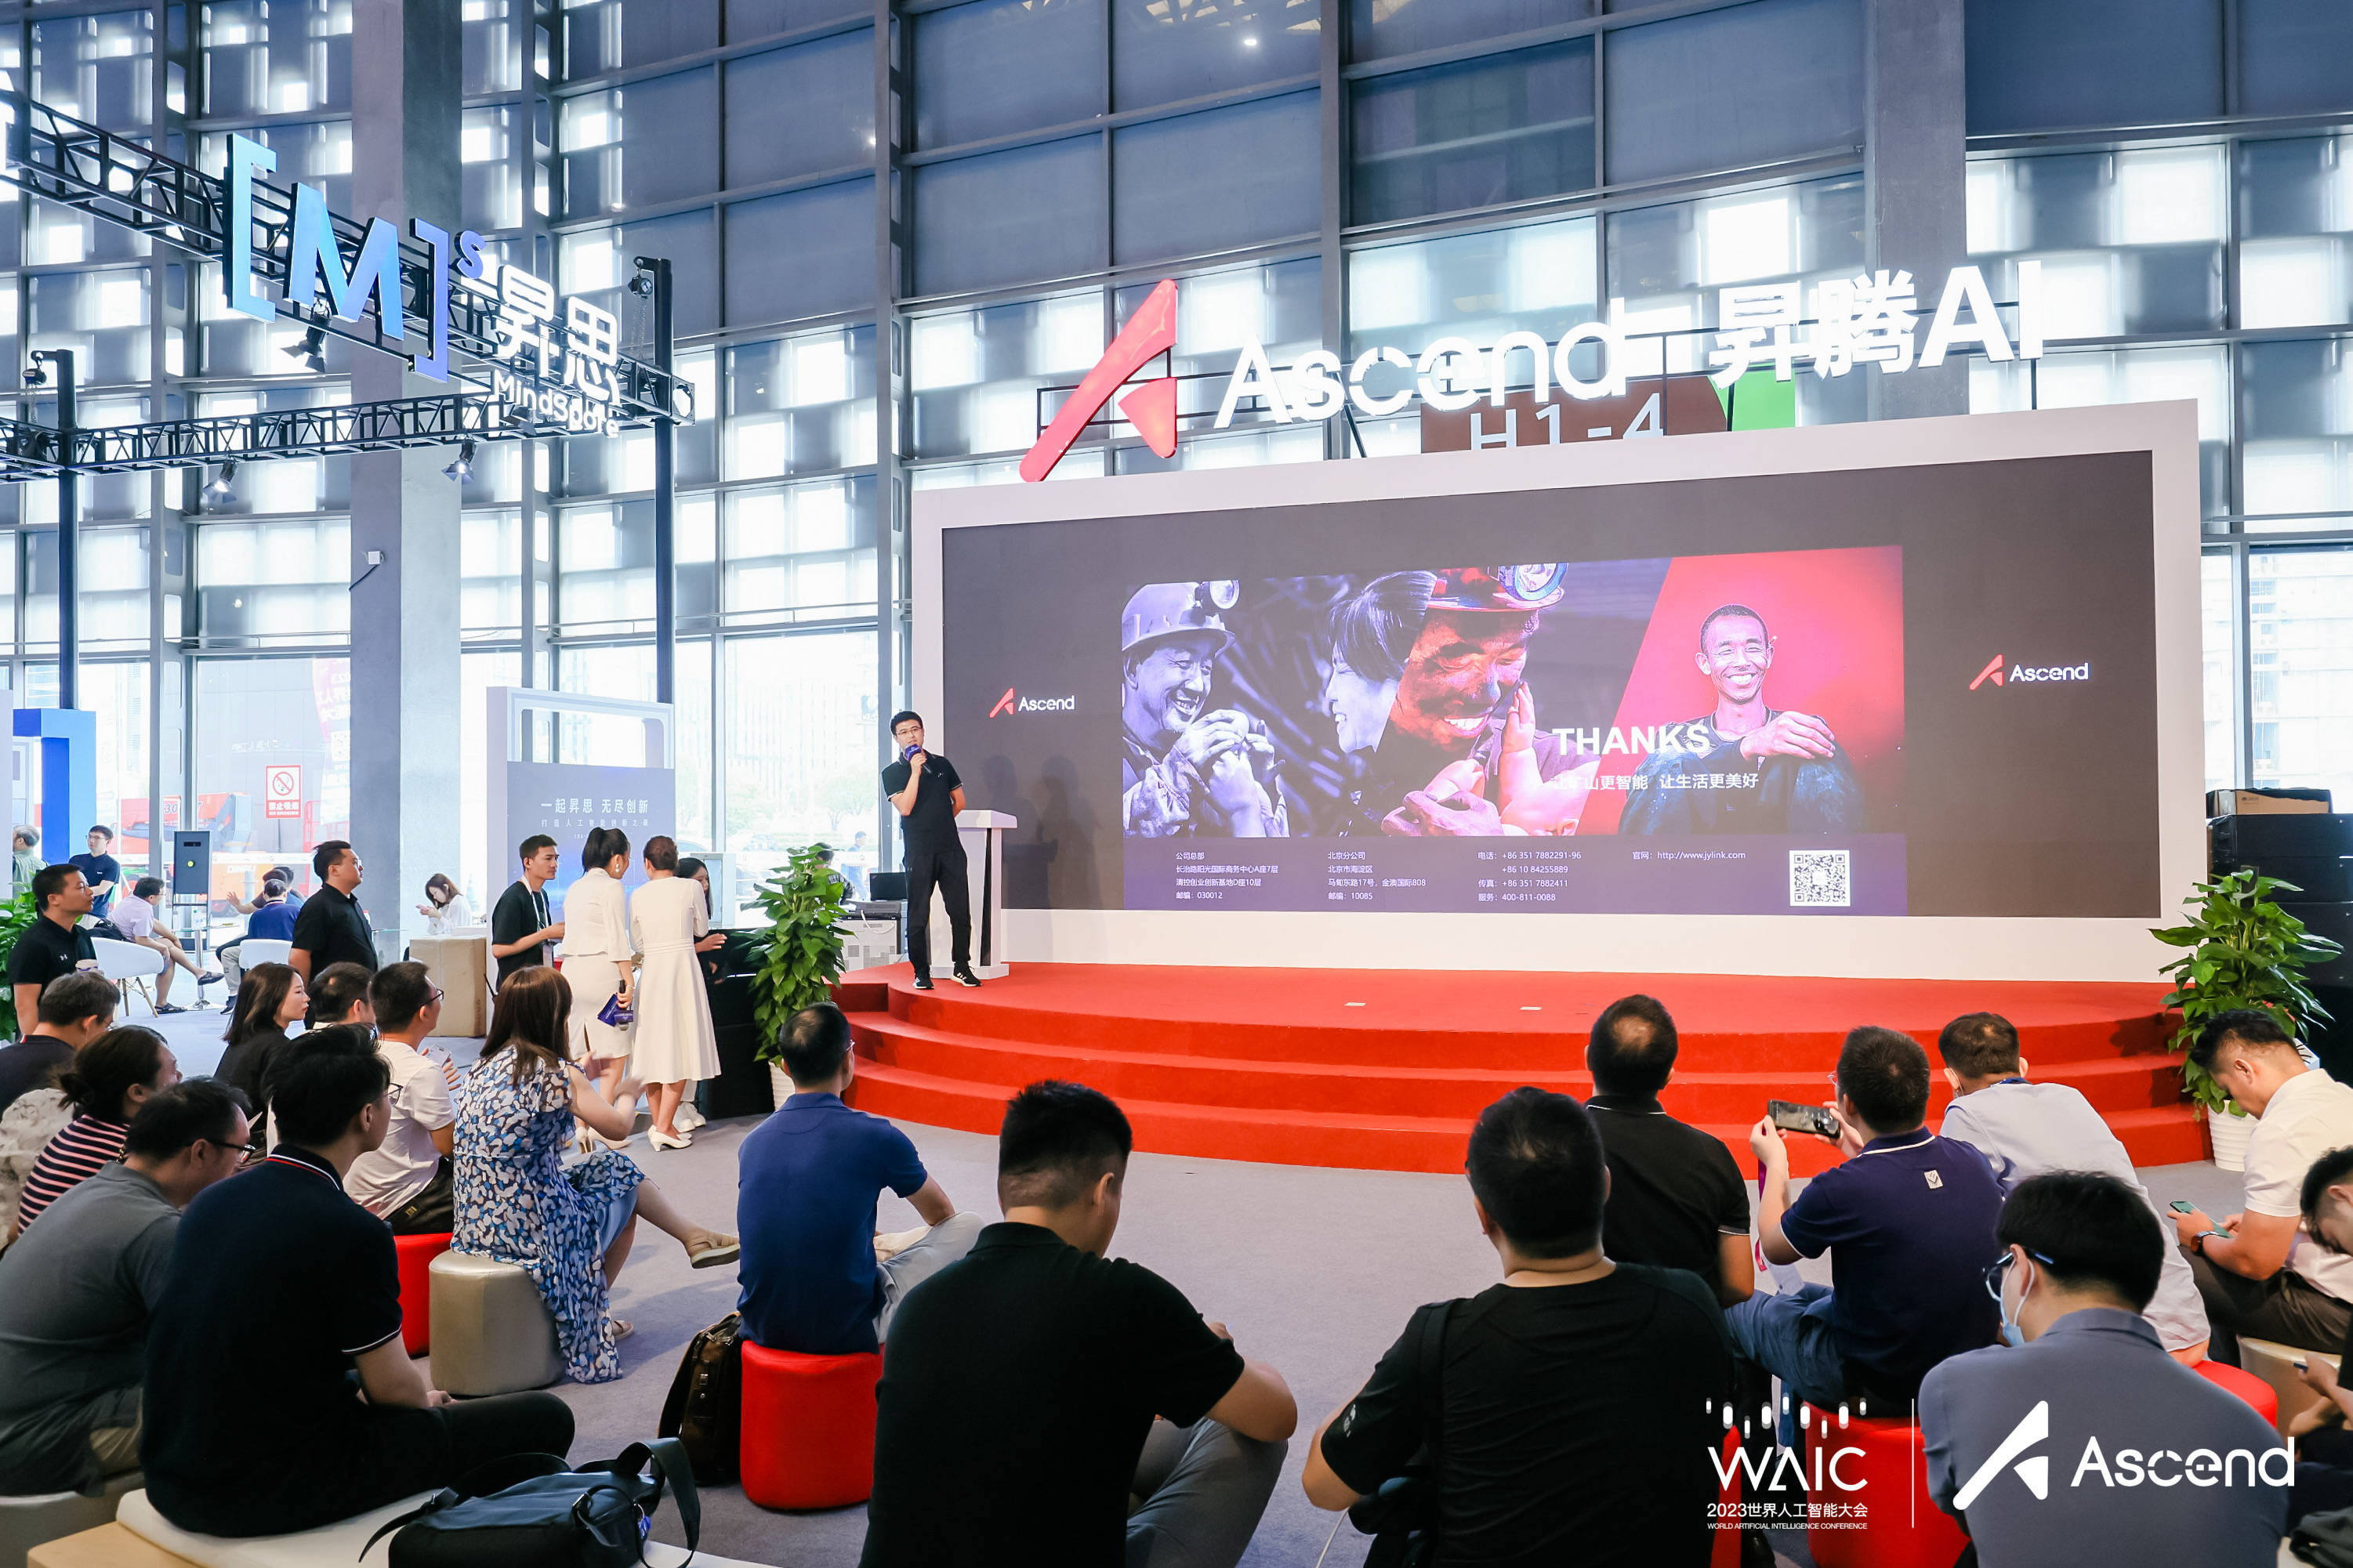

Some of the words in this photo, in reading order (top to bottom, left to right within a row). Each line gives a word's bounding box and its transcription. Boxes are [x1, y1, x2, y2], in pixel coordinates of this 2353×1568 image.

[494, 264, 621, 407] 昇思
[1709, 259, 2044, 388] 昇腾AI
[1213, 296, 1626, 429] Ascend
[493, 369, 619, 438] MindSpore
[1470, 392, 1665, 451] H1-4
[2009, 662, 2090, 683] Ascend
[1017, 694, 1075, 712] Ascend
[1551, 723, 1711, 755] THANKS
[1659, 773, 1759, 789] 让生活更美好
[541, 798, 593, 814] 一起昇思
[601, 798, 648, 813] 无尽创新
